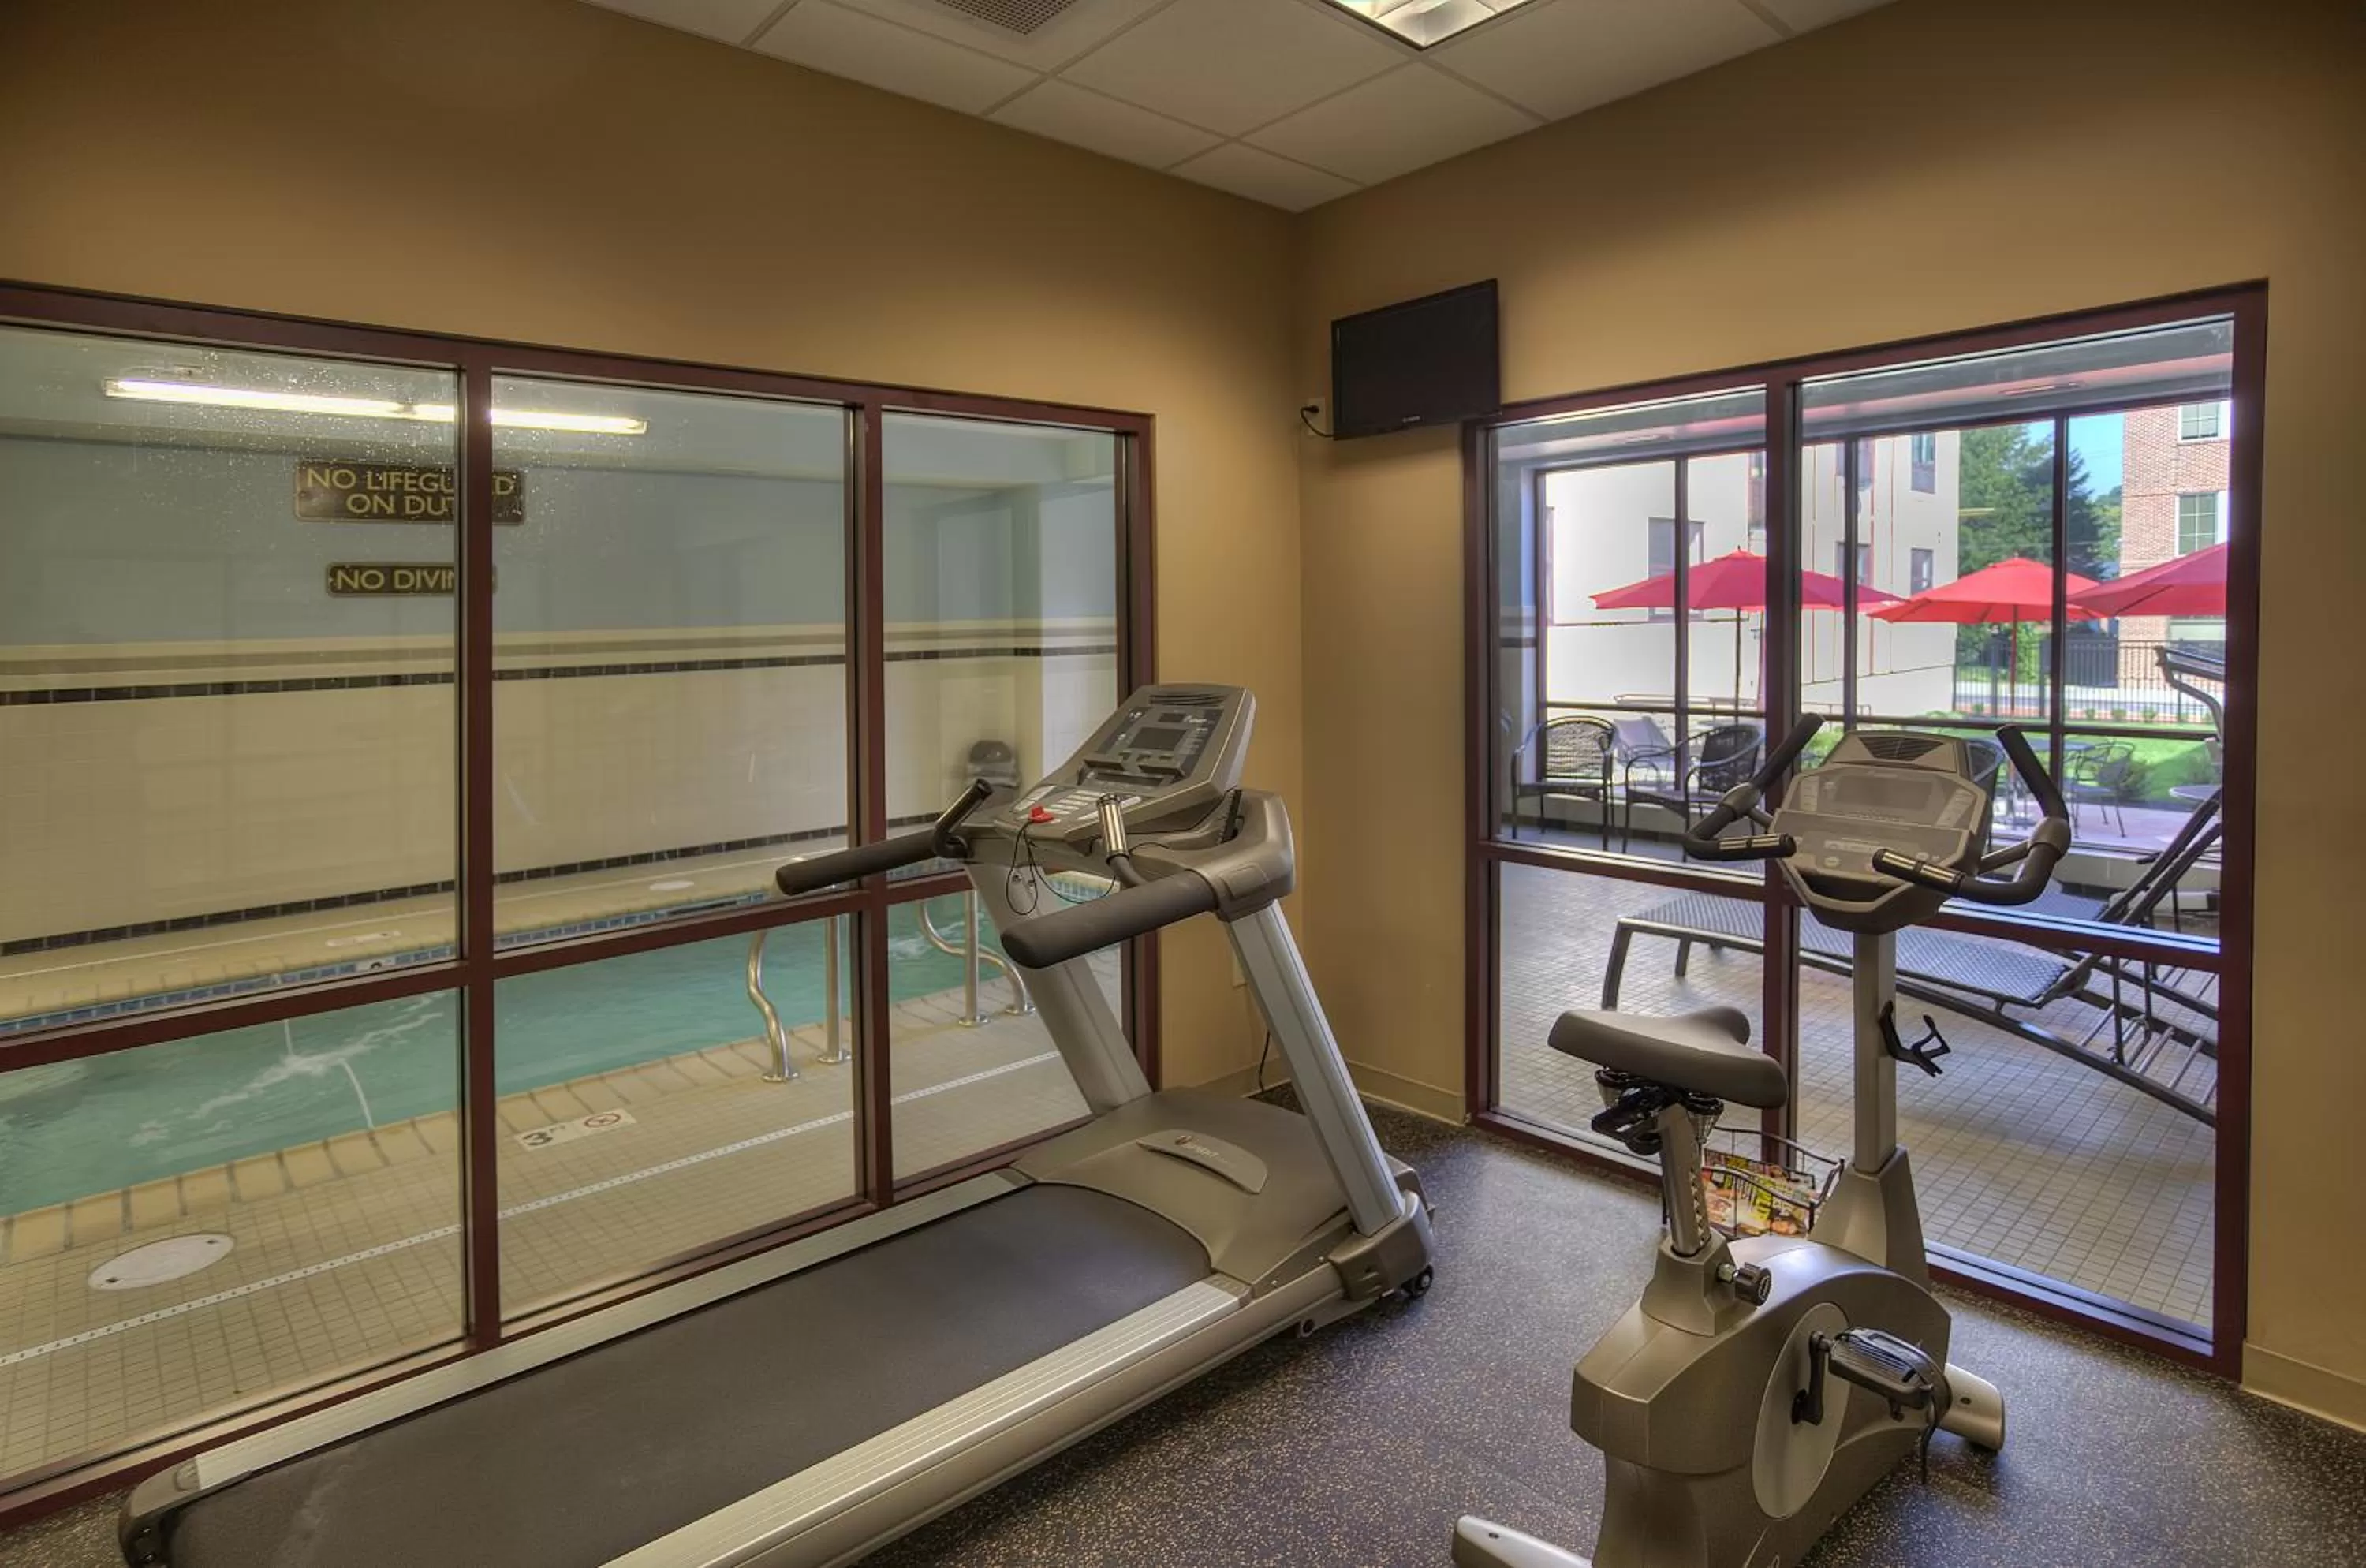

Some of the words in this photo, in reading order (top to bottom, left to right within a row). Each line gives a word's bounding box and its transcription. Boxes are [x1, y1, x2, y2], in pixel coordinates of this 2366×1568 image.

[307, 469, 356, 489] NO
[367, 471, 513, 495] LIFEGUD
[346, 494, 394, 514] ON
[337, 569, 384, 590] NO
[394, 570, 454, 590] DIVI
[522, 1131, 553, 1146] 3
